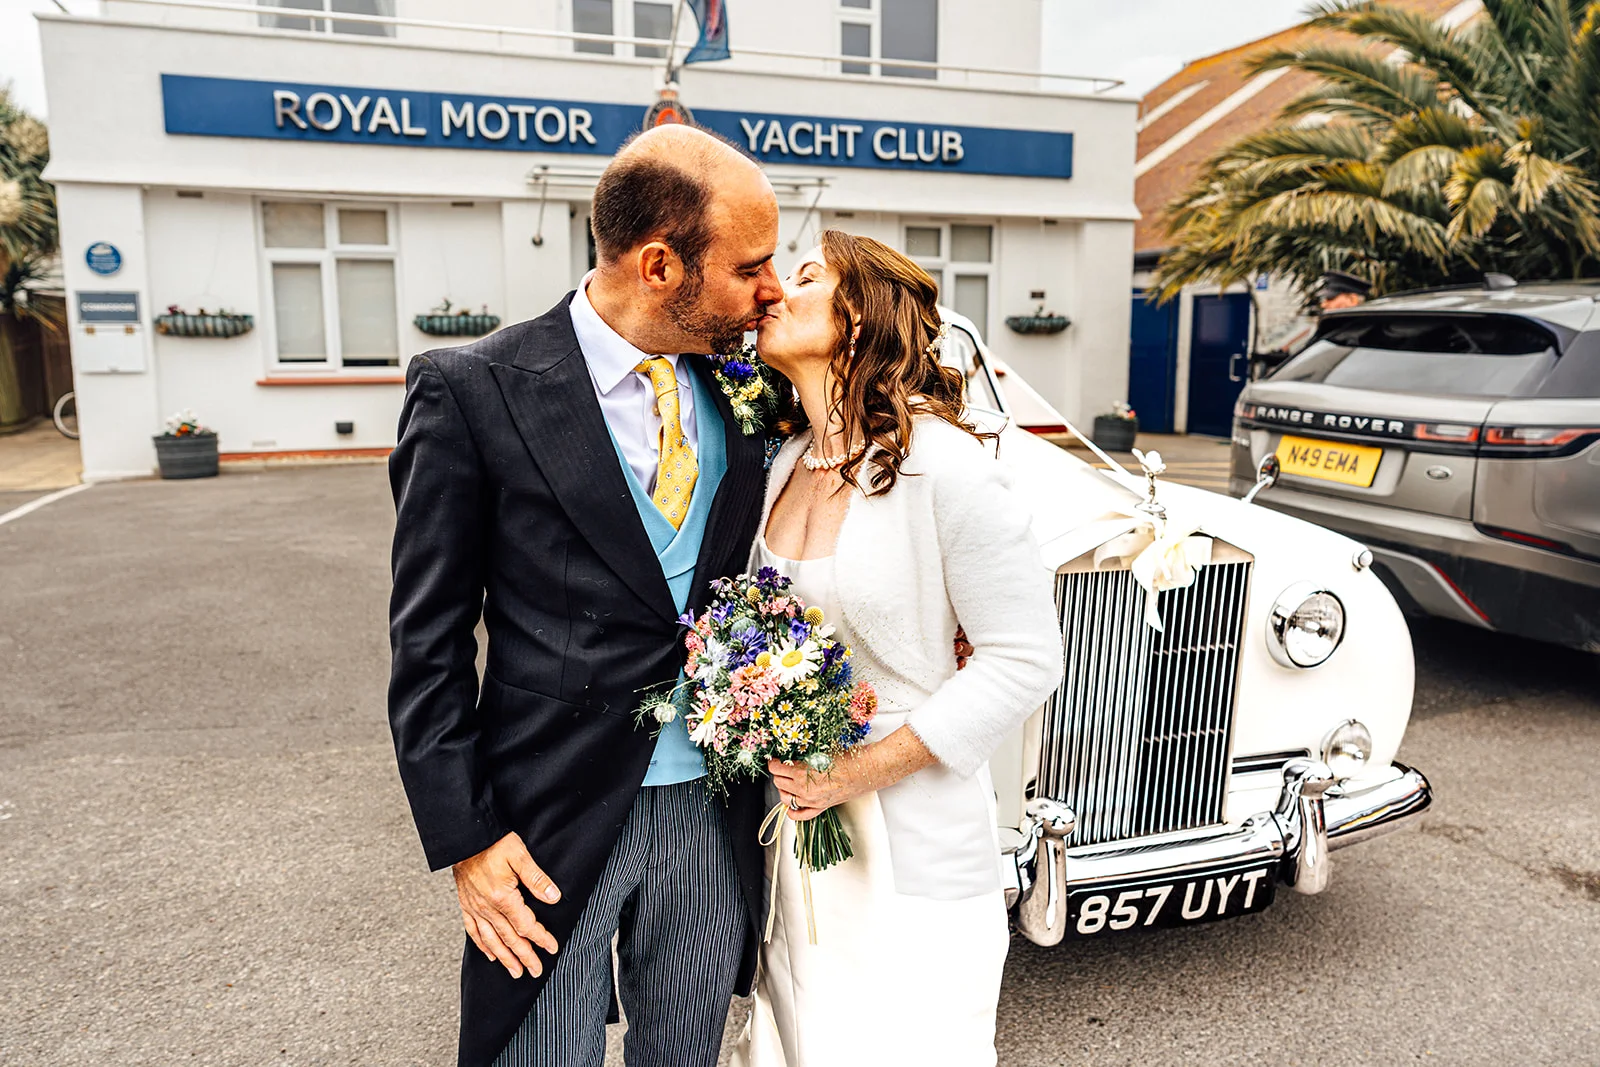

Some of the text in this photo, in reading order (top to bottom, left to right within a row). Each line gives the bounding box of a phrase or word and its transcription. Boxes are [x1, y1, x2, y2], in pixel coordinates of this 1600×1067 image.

[273, 90, 427, 136] ROYAL
[441, 100, 597, 145] MOTOR
[740, 117, 863, 158] YACHT
[872, 127, 965, 163] CLUB
[1257, 406, 1405, 434] RANGE ROVER
[1287, 446, 1360, 474] N49 EMA
[1076, 868, 1267, 934] 857 UYT
